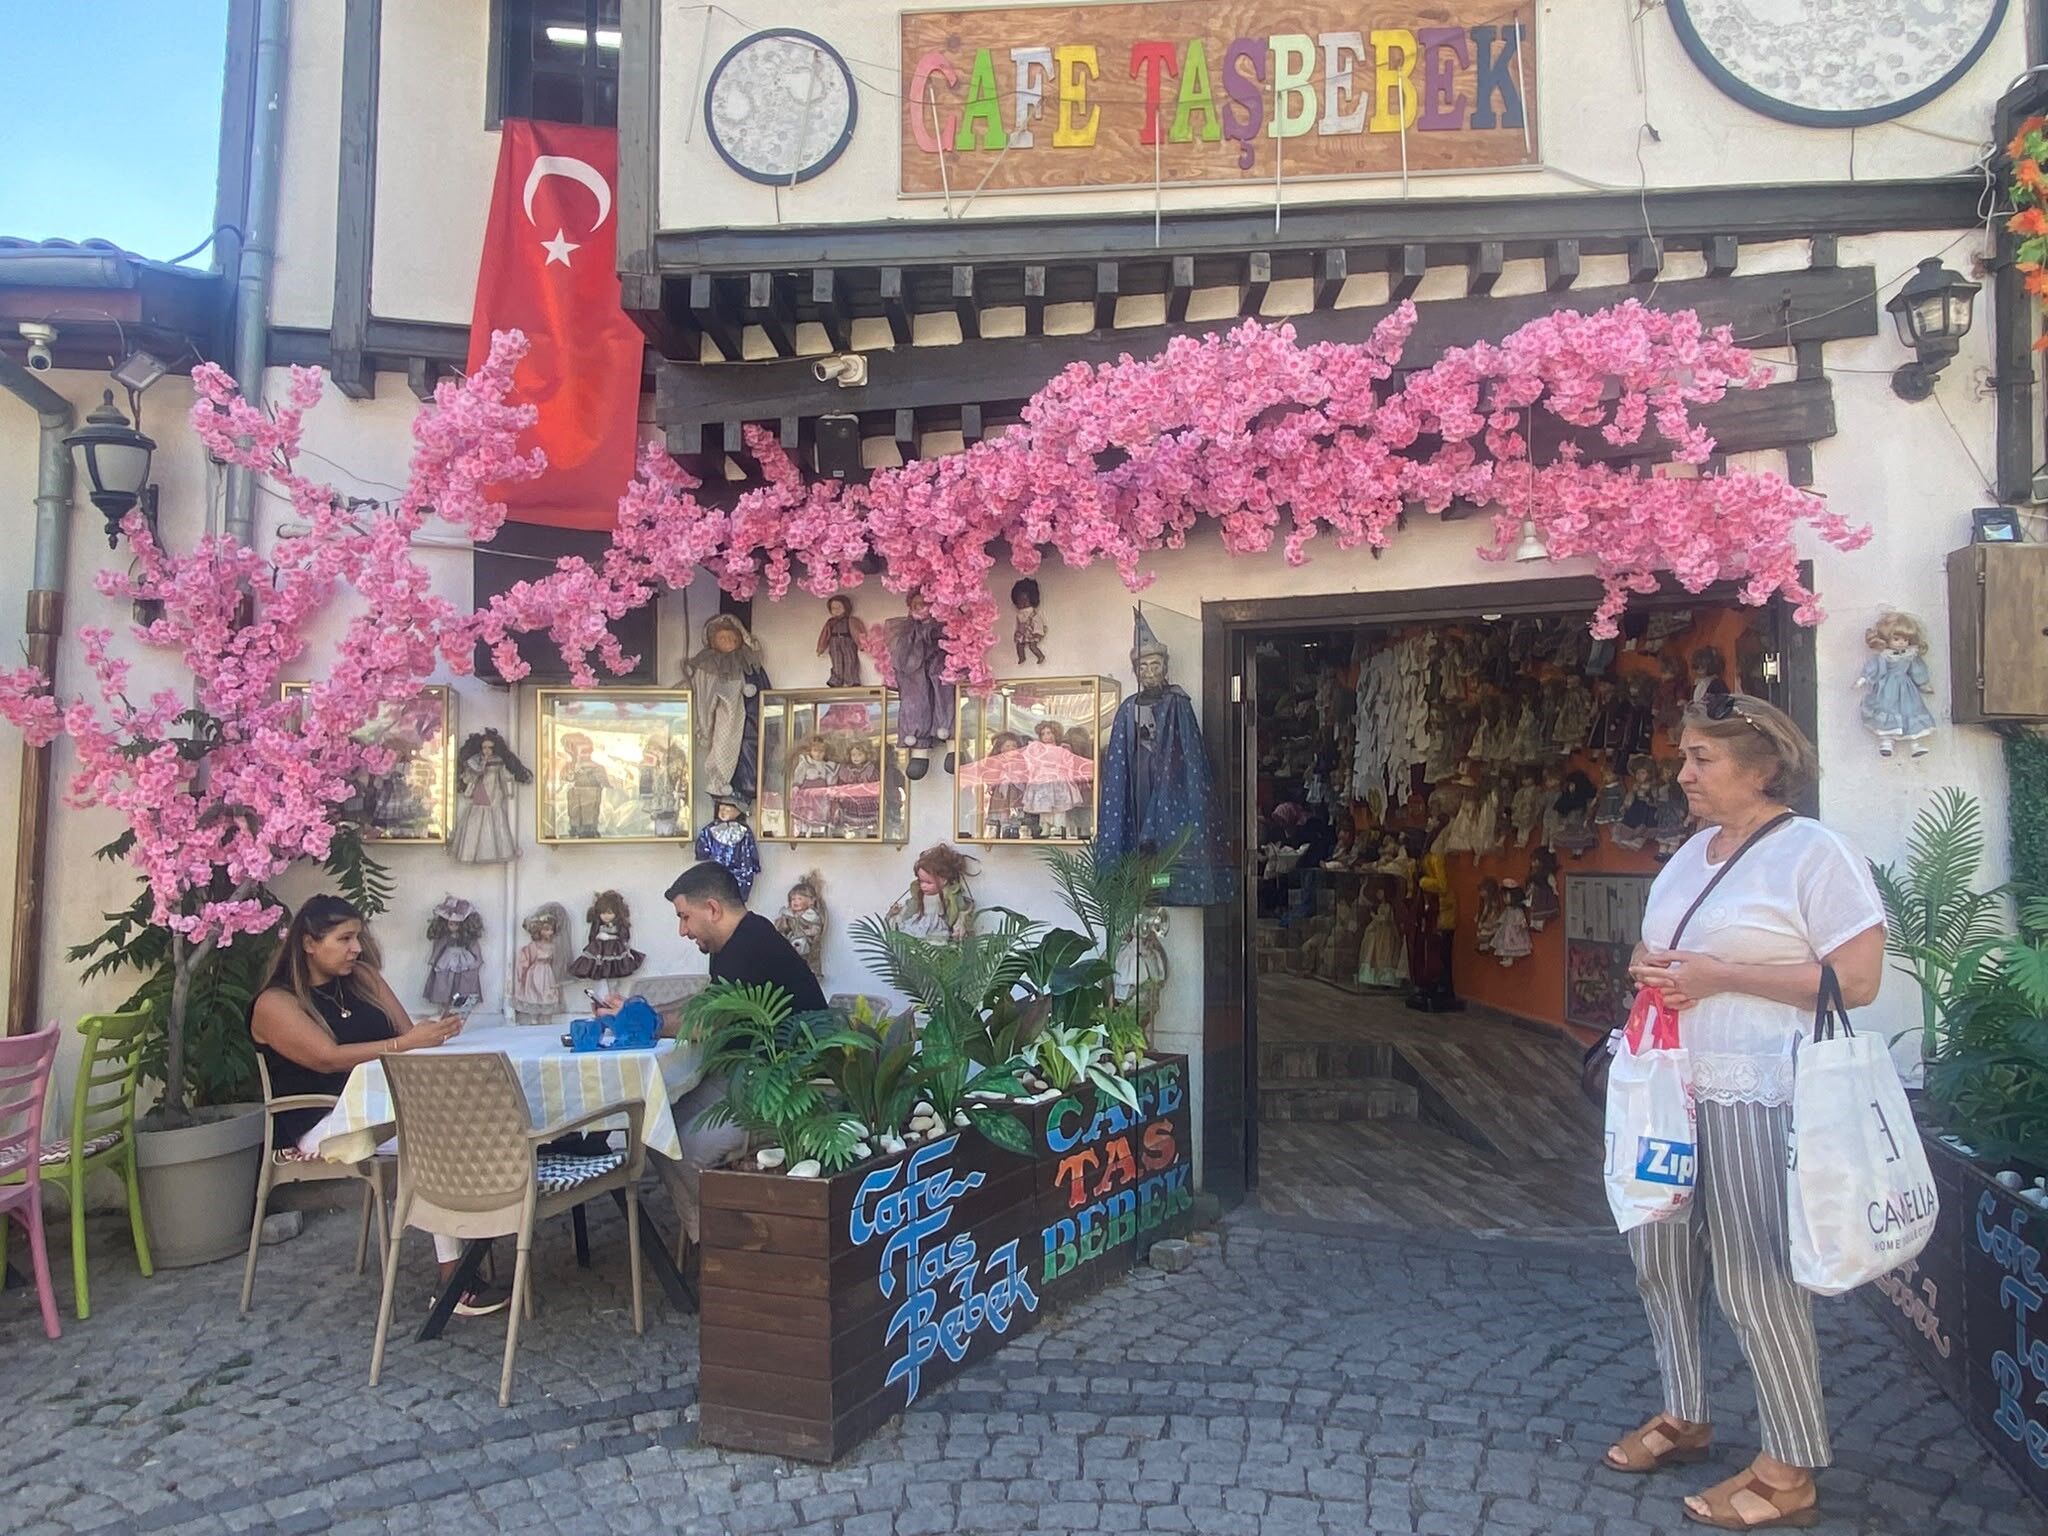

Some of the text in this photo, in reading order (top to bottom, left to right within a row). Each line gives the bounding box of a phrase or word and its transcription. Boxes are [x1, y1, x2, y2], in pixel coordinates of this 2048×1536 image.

[909, 23, 1527, 171] CAFE TAŞBEBEK
[850, 1133, 986, 1246] Cafe
[1054, 1118, 1179, 1208] TAS
[1041, 1163, 1194, 1285] BEBEK
